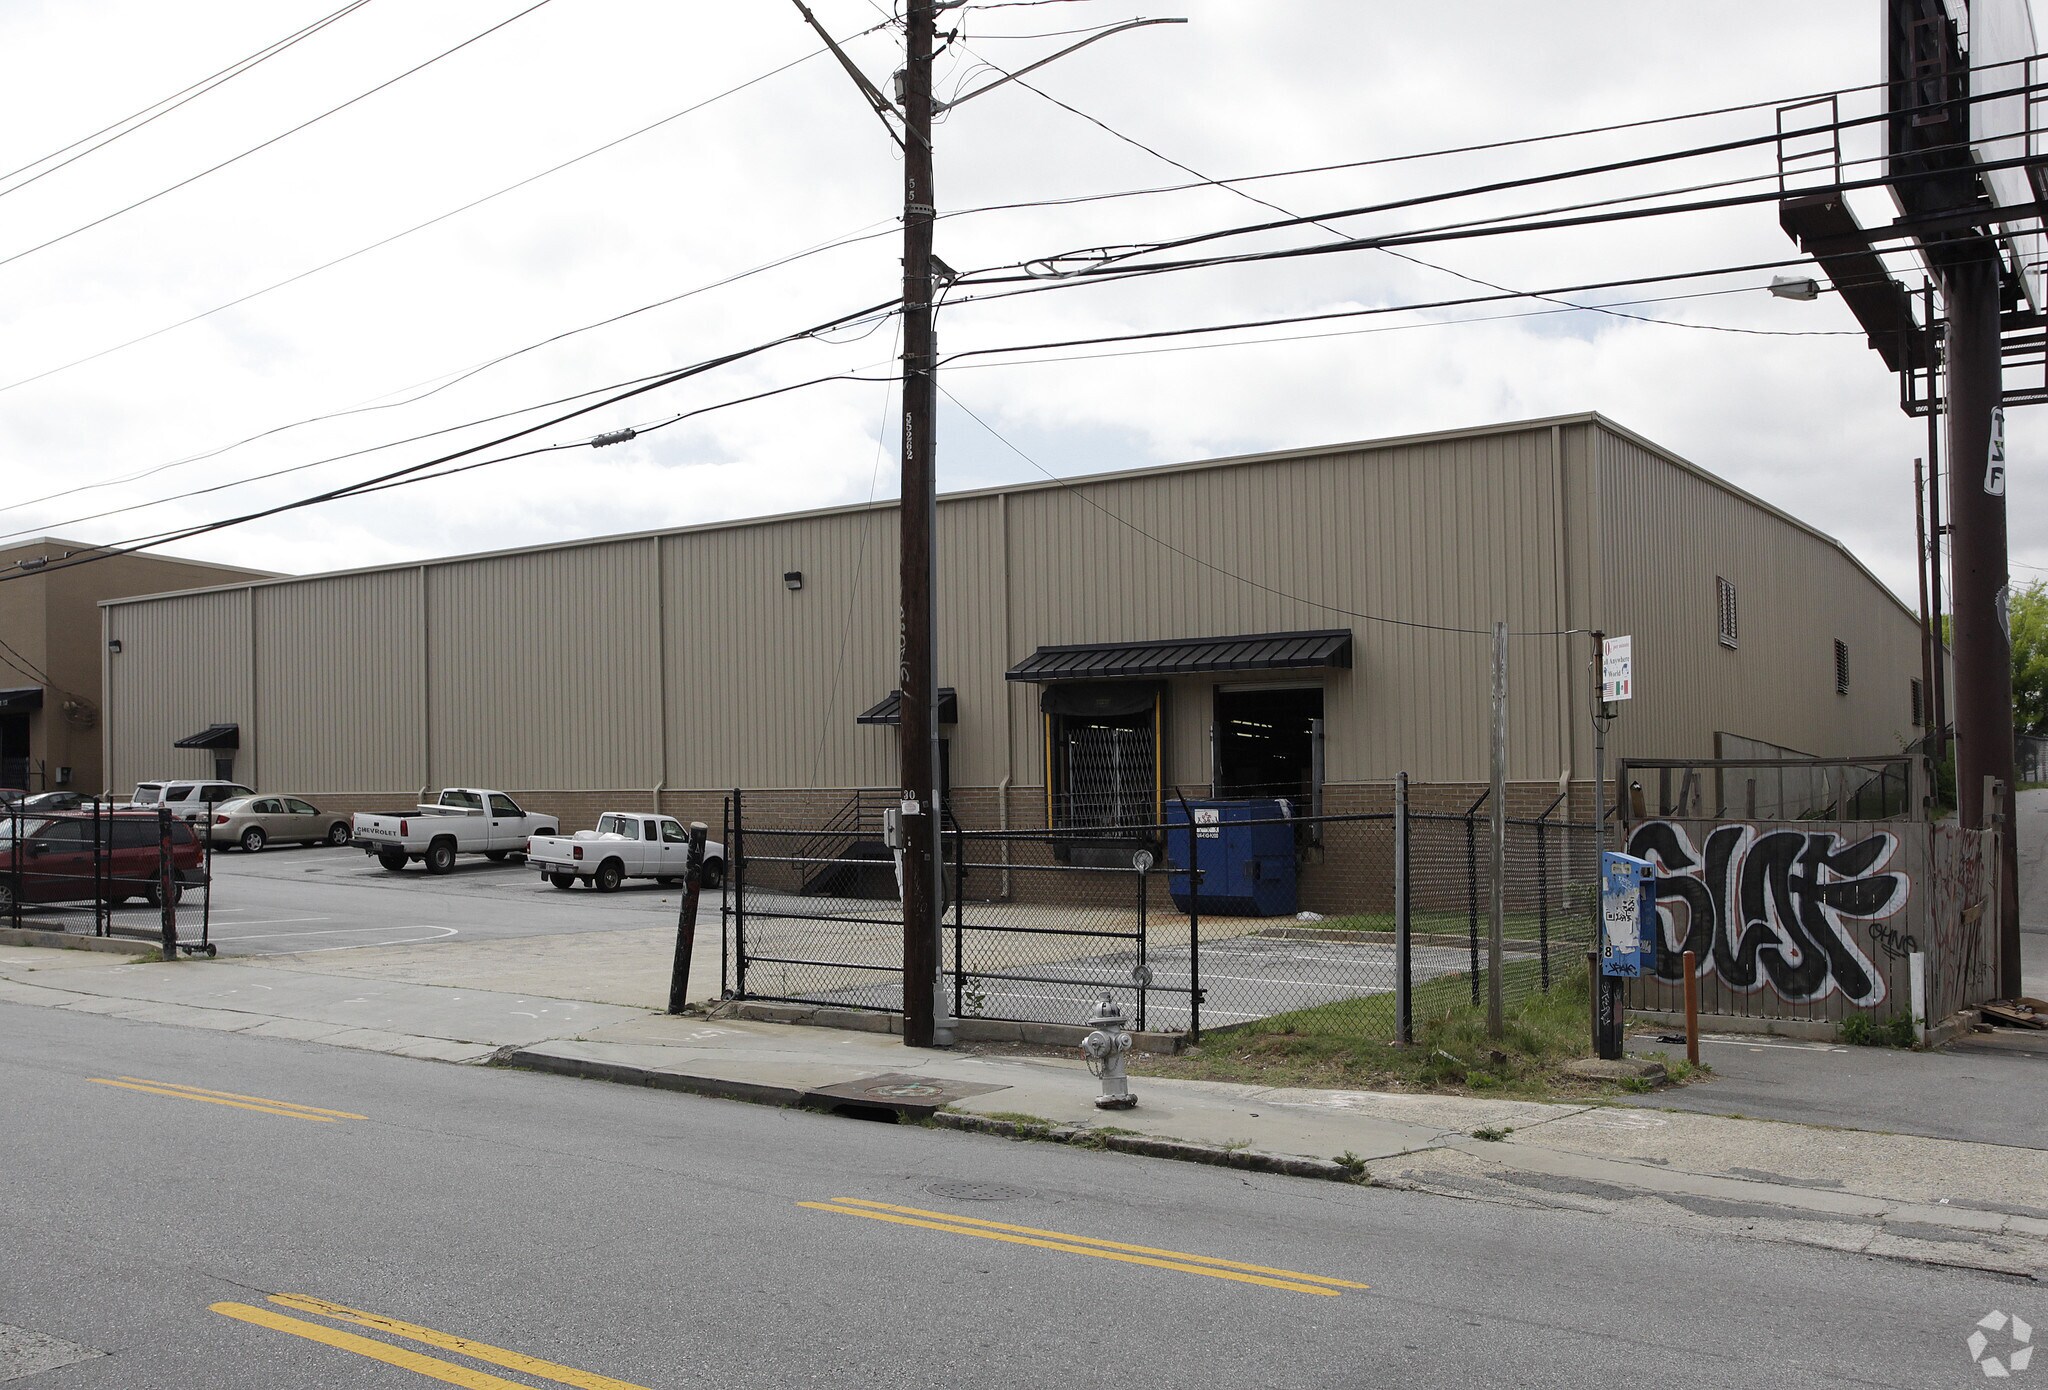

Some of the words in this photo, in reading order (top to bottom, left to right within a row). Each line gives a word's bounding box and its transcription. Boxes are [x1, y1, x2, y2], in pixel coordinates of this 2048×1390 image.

[903, 789, 916, 800] 30
[357, 826, 396, 836] CHEVROLET
[1604, 946, 1613, 958] 8
